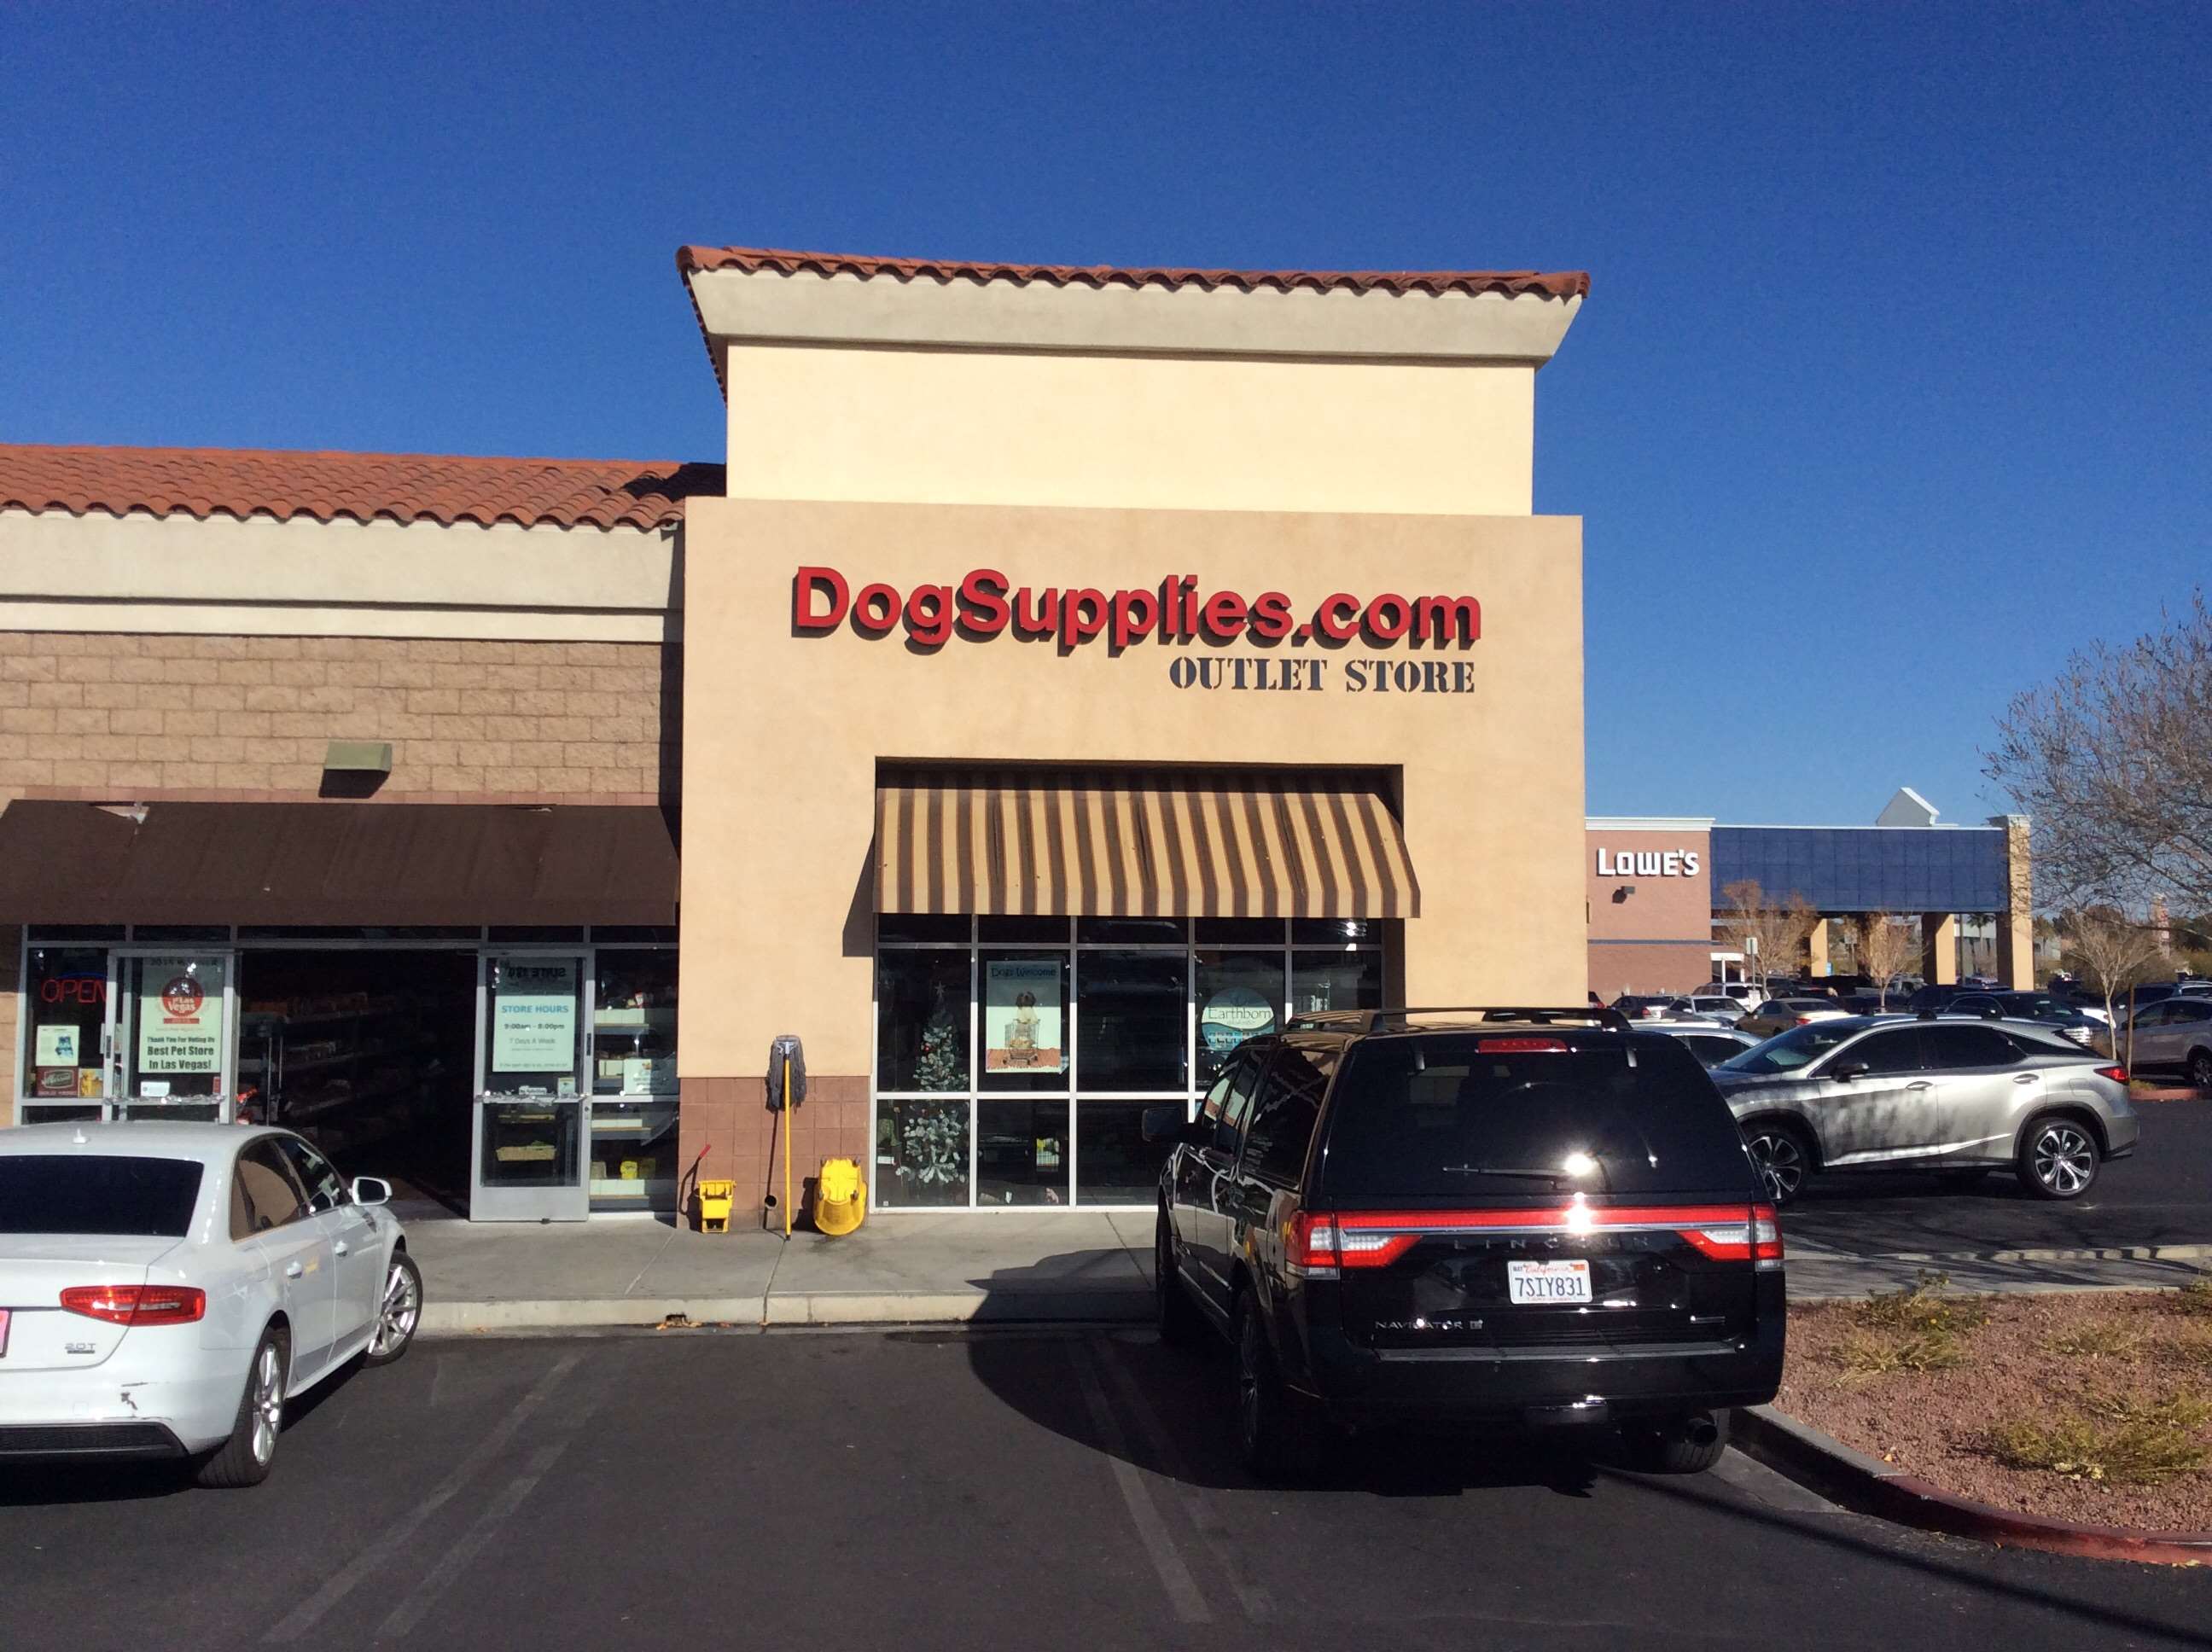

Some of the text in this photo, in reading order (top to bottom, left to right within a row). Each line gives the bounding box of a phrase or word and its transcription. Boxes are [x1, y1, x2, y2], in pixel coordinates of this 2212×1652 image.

[792, 567, 1481, 650] DogSupplies.com
[1170, 656, 1476, 693] OUTLET STORE
[1598, 847, 1700, 875] LOWE'S
[41, 978, 106, 1003] OPEN
[502, 1005, 533, 1014] STORE
[148, 1046, 214, 1056] Best Pet Store
[148, 1060, 212, 1070] In Las Vegas!
[1515, 1277, 1586, 1297] 7SIY831
